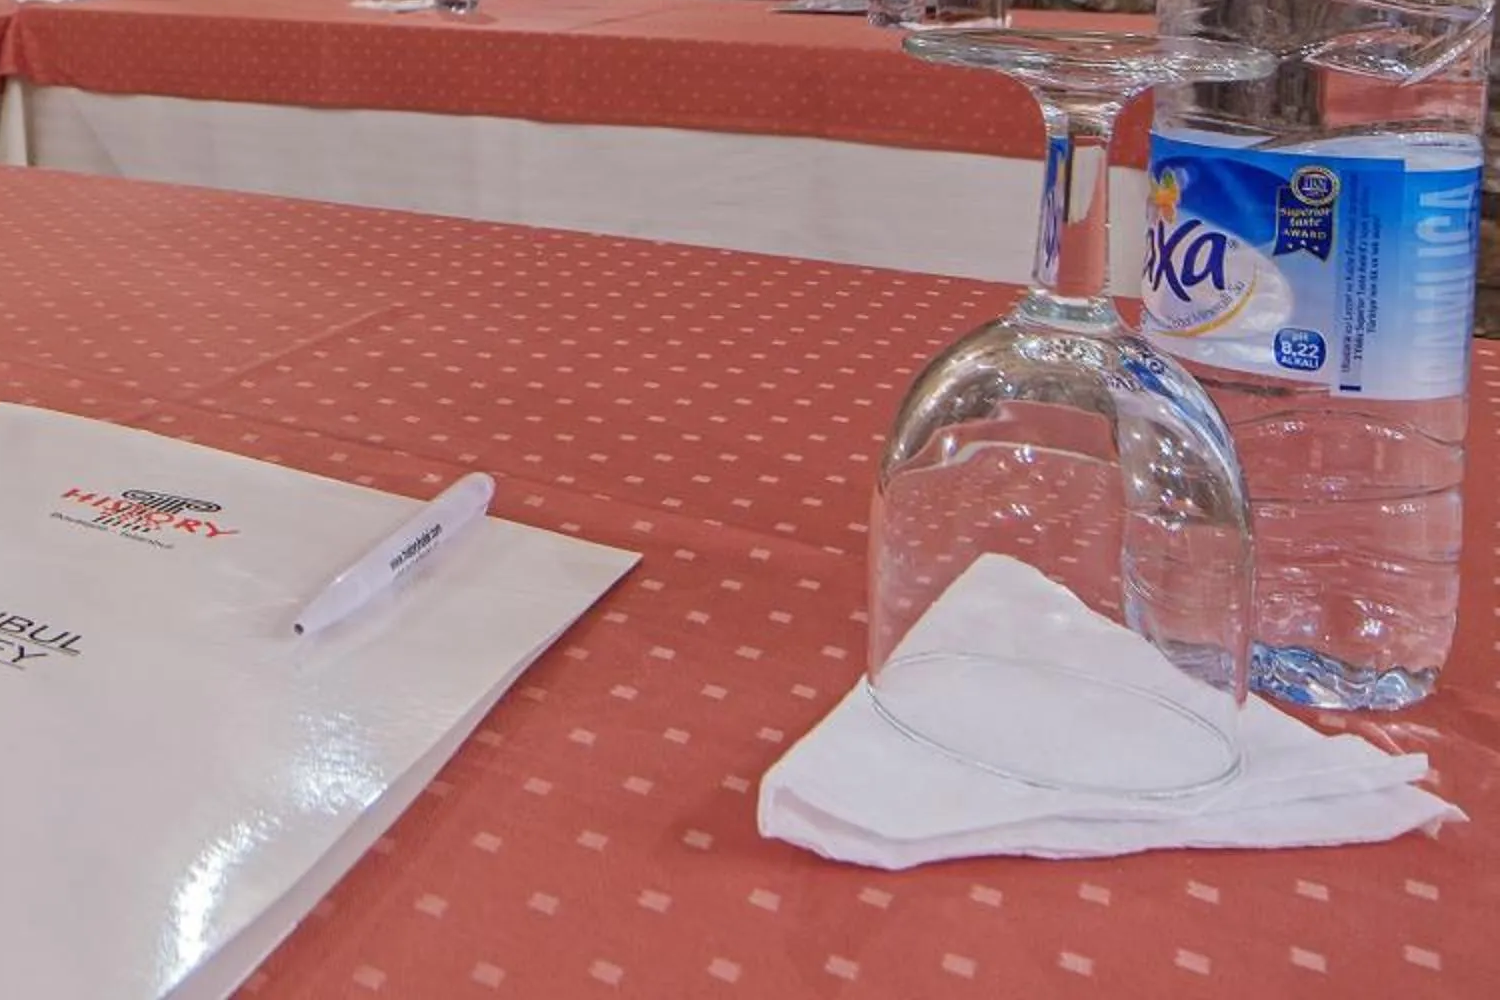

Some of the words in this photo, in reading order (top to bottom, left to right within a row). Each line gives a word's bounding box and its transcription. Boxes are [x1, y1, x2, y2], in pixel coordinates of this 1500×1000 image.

[1283, 228, 1327, 239] AWARD
[1281, 341, 1320, 358] 8.22
[60, 488, 241, 538] HISTORY
